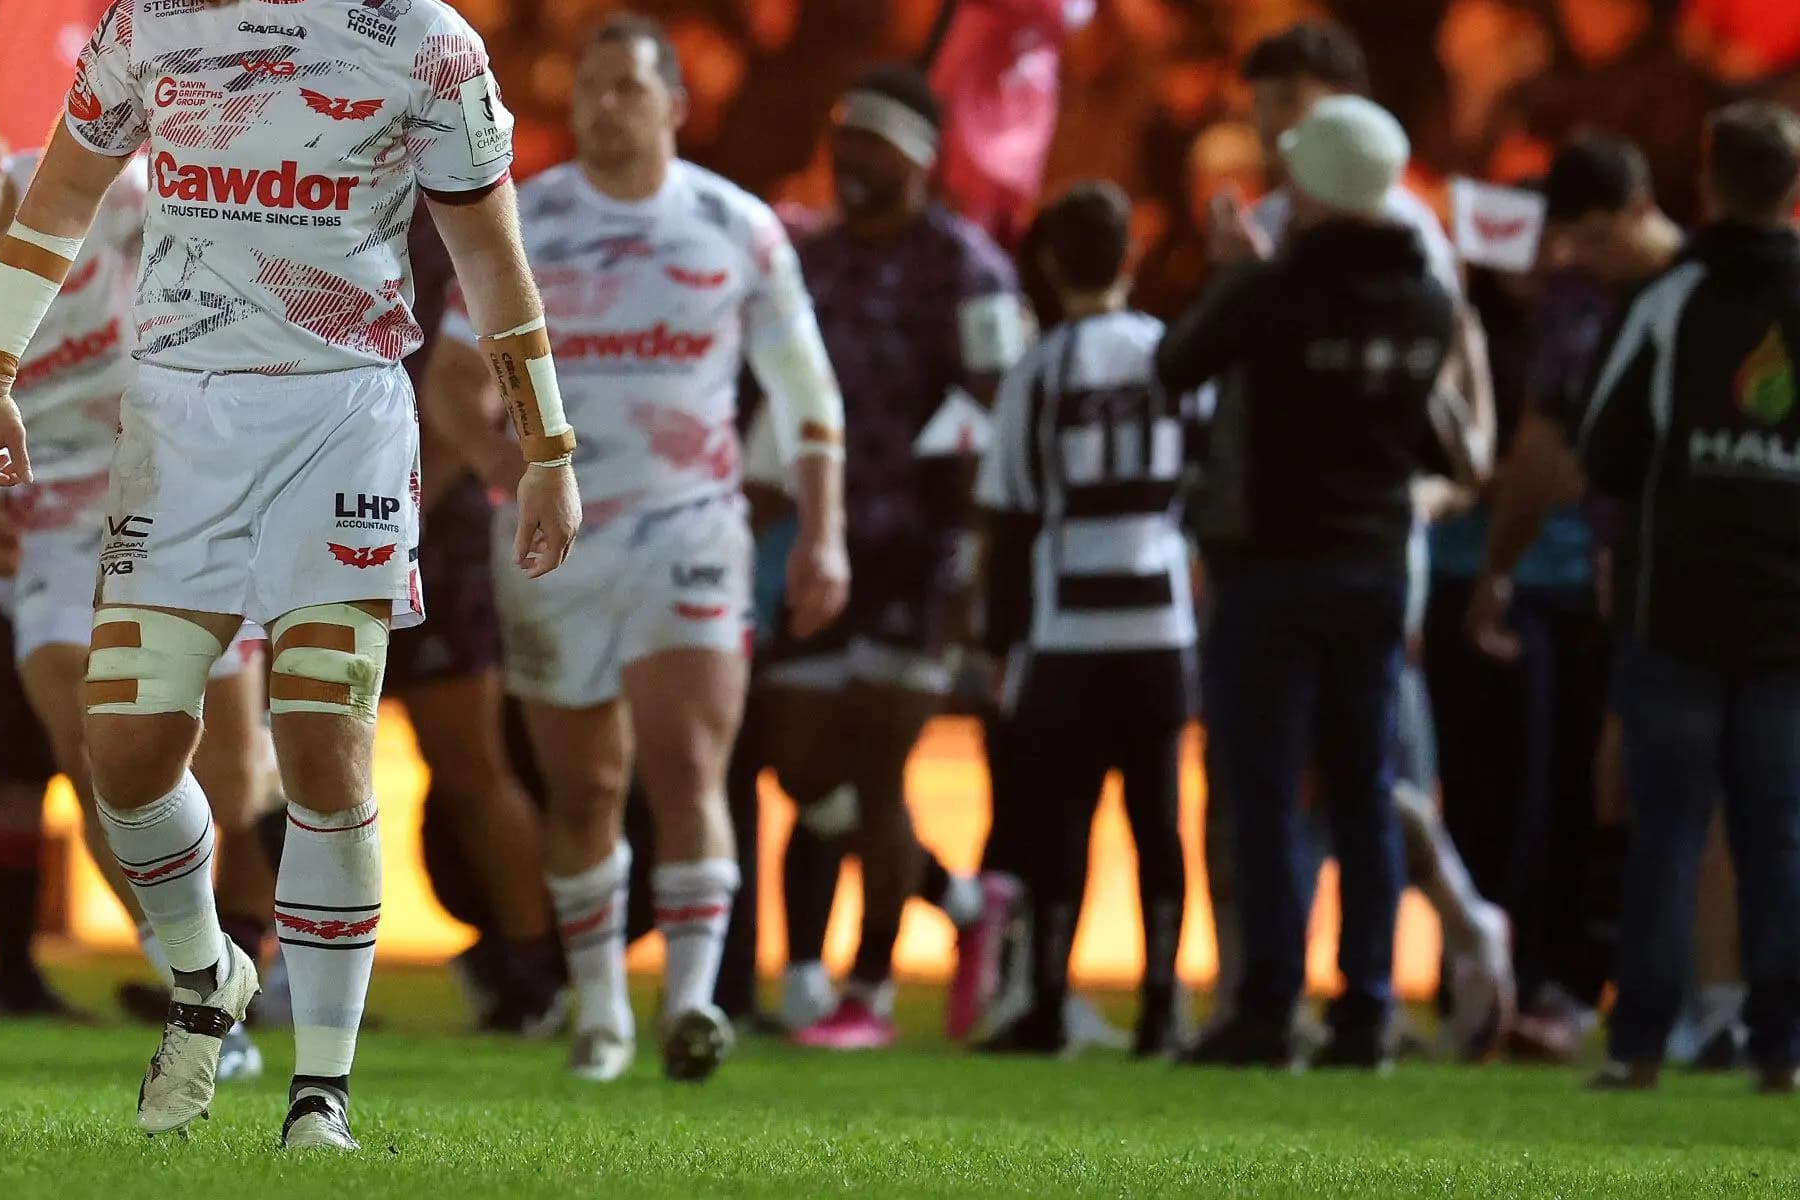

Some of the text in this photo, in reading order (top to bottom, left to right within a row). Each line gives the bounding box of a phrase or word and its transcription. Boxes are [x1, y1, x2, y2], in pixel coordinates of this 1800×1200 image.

[238, 21, 294, 36] GRAVELLS
[347, 9, 397, 36] Castell
[347, 20, 396, 47] Howell
[179, 80, 206, 89] GAVIN
[176, 99, 206, 107] GROUP
[178, 90, 224, 99] GRIFFITHS
[155, 151, 360, 211] Cawdor
[167, 204, 218, 219] TRUSTED
[222, 209, 262, 223] NAME
[265, 213, 308, 226] SINCE
[312, 215, 342, 227] 1985
[335, 492, 400, 520] LHP
[336, 520, 400, 533] ACCOUNTANTS
